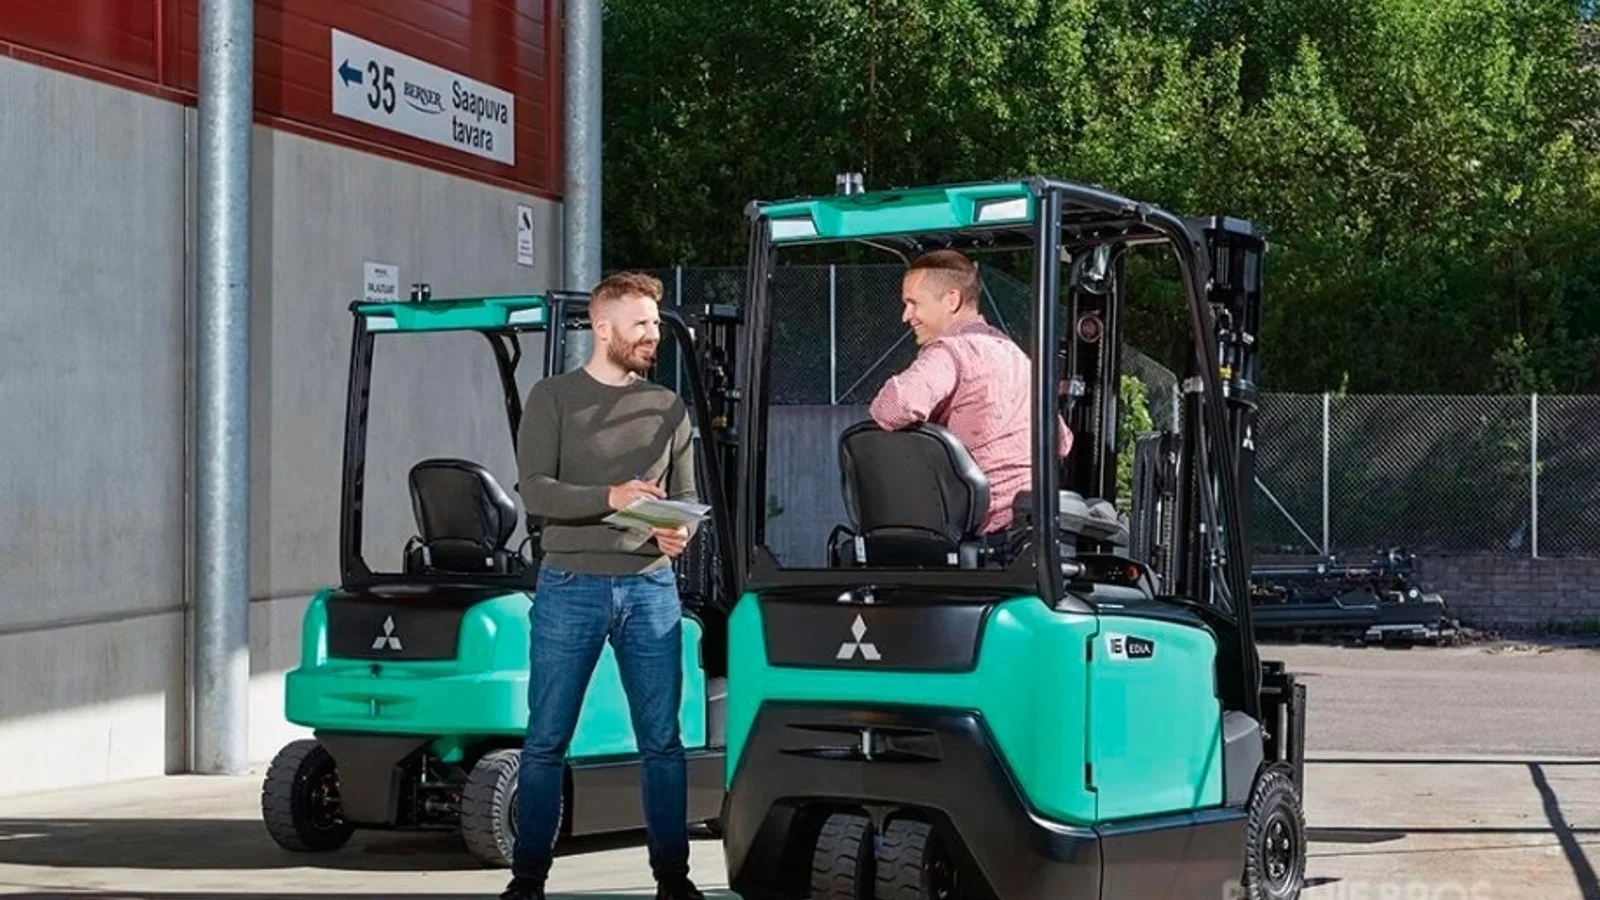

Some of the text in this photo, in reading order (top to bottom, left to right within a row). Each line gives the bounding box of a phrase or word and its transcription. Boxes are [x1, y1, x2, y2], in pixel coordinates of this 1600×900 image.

[367, 60, 396, 115] 35
[452, 80, 508, 124] Saapuva
[452, 115, 494, 152] tavara
